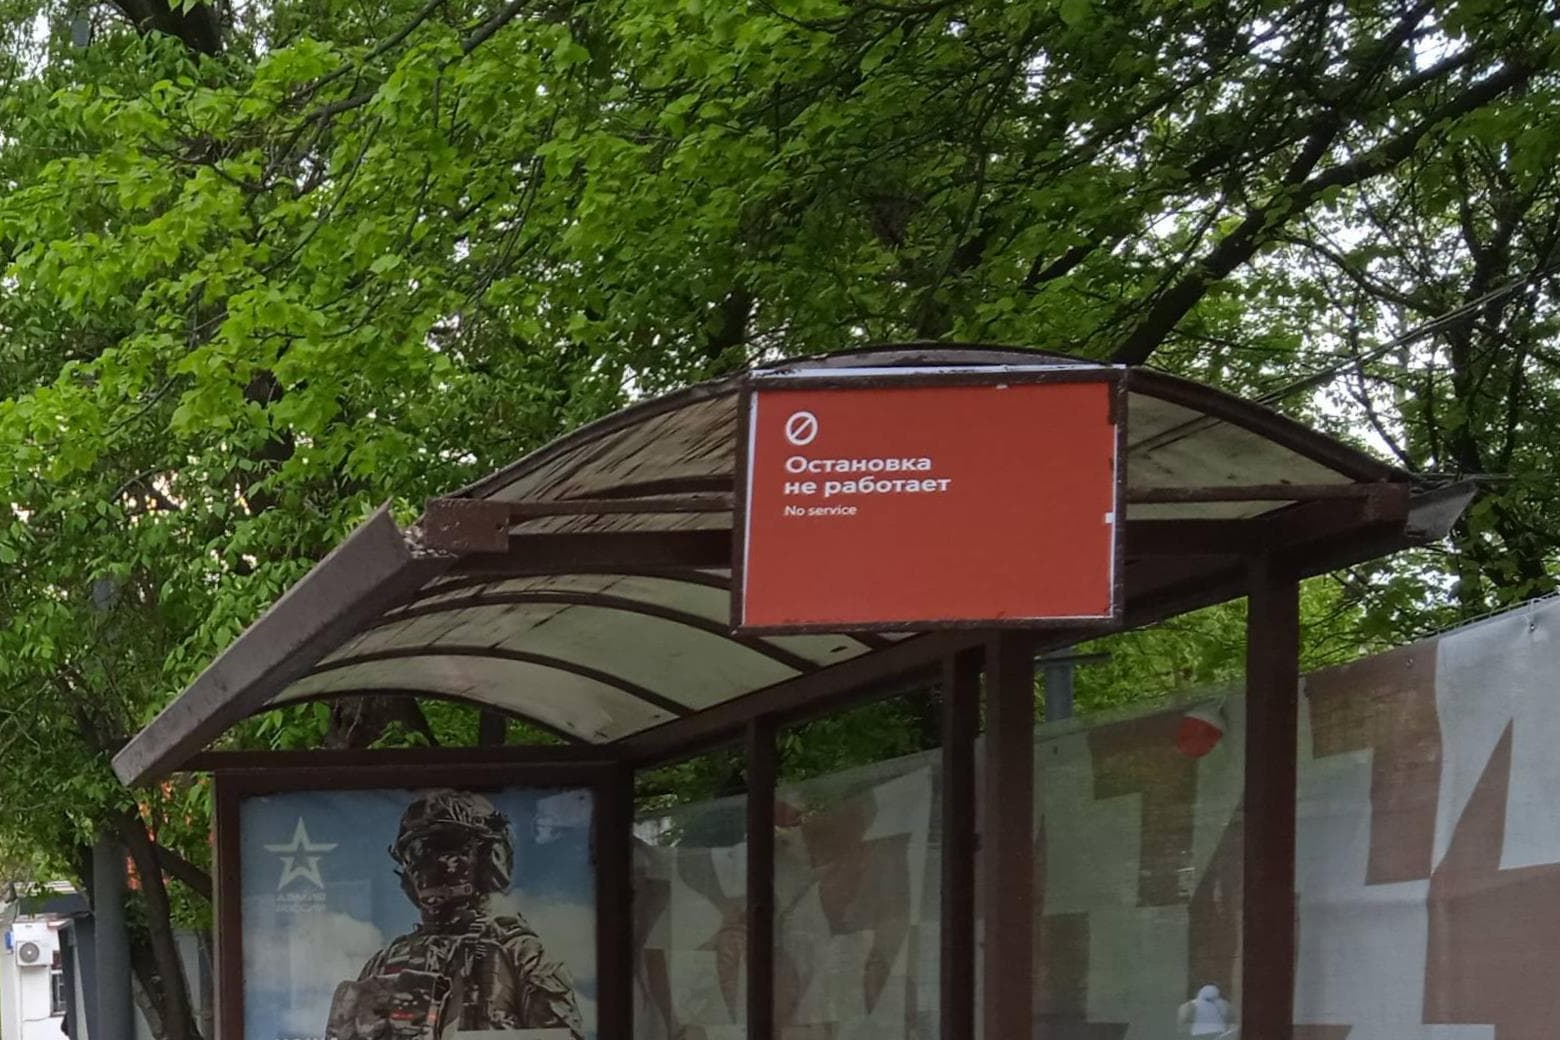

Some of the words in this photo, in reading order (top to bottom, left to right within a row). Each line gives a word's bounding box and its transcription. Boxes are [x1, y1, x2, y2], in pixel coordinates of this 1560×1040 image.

[785, 456, 931, 474] Остановка
[784, 480, 815, 495] не
[824, 476, 951, 497] работает
[784, 505, 805, 516] No
[808, 504, 857, 516] service
